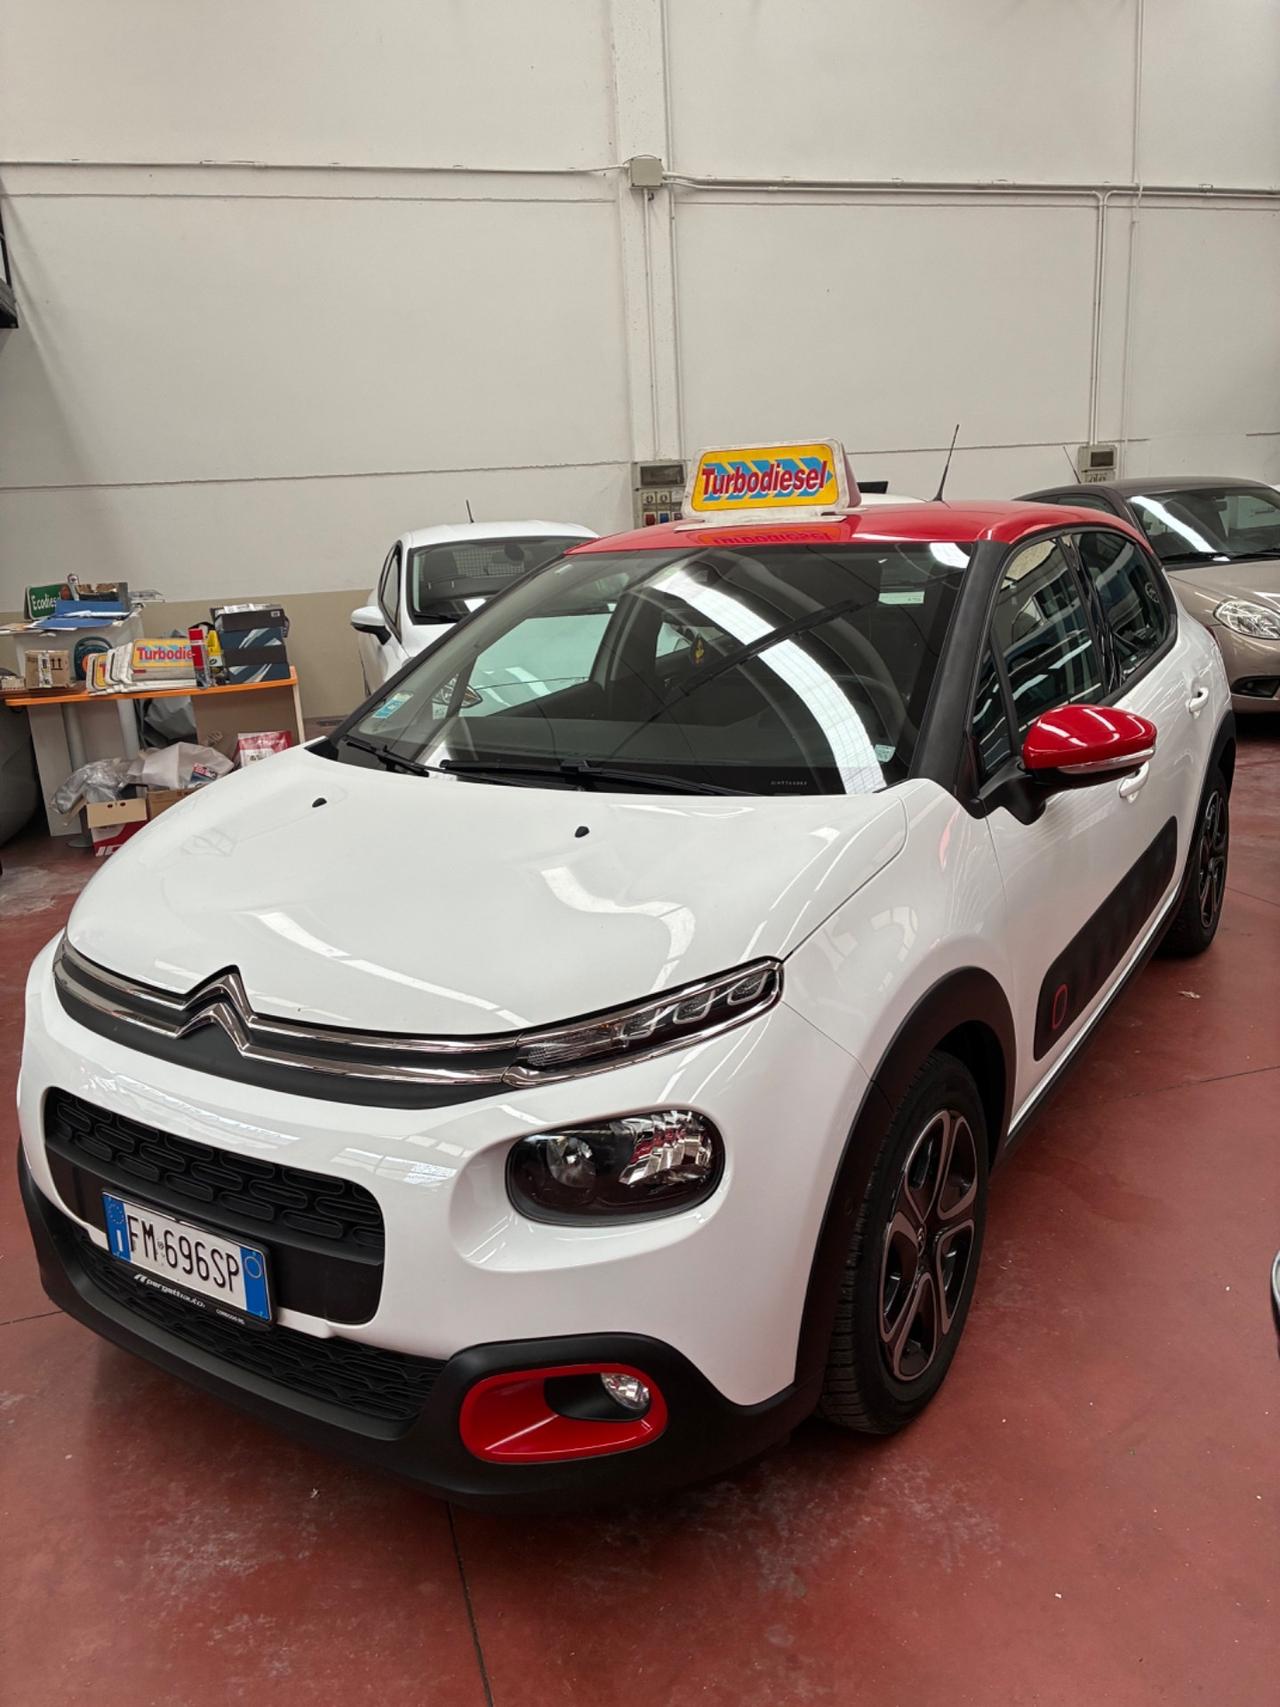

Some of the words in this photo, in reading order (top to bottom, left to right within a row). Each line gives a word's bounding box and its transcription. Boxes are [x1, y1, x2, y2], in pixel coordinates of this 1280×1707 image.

[701, 460, 827, 496] Turbodiesel
[32, 592, 62, 611] Ecodiesl
[136, 647, 193, 660] Turbodie
